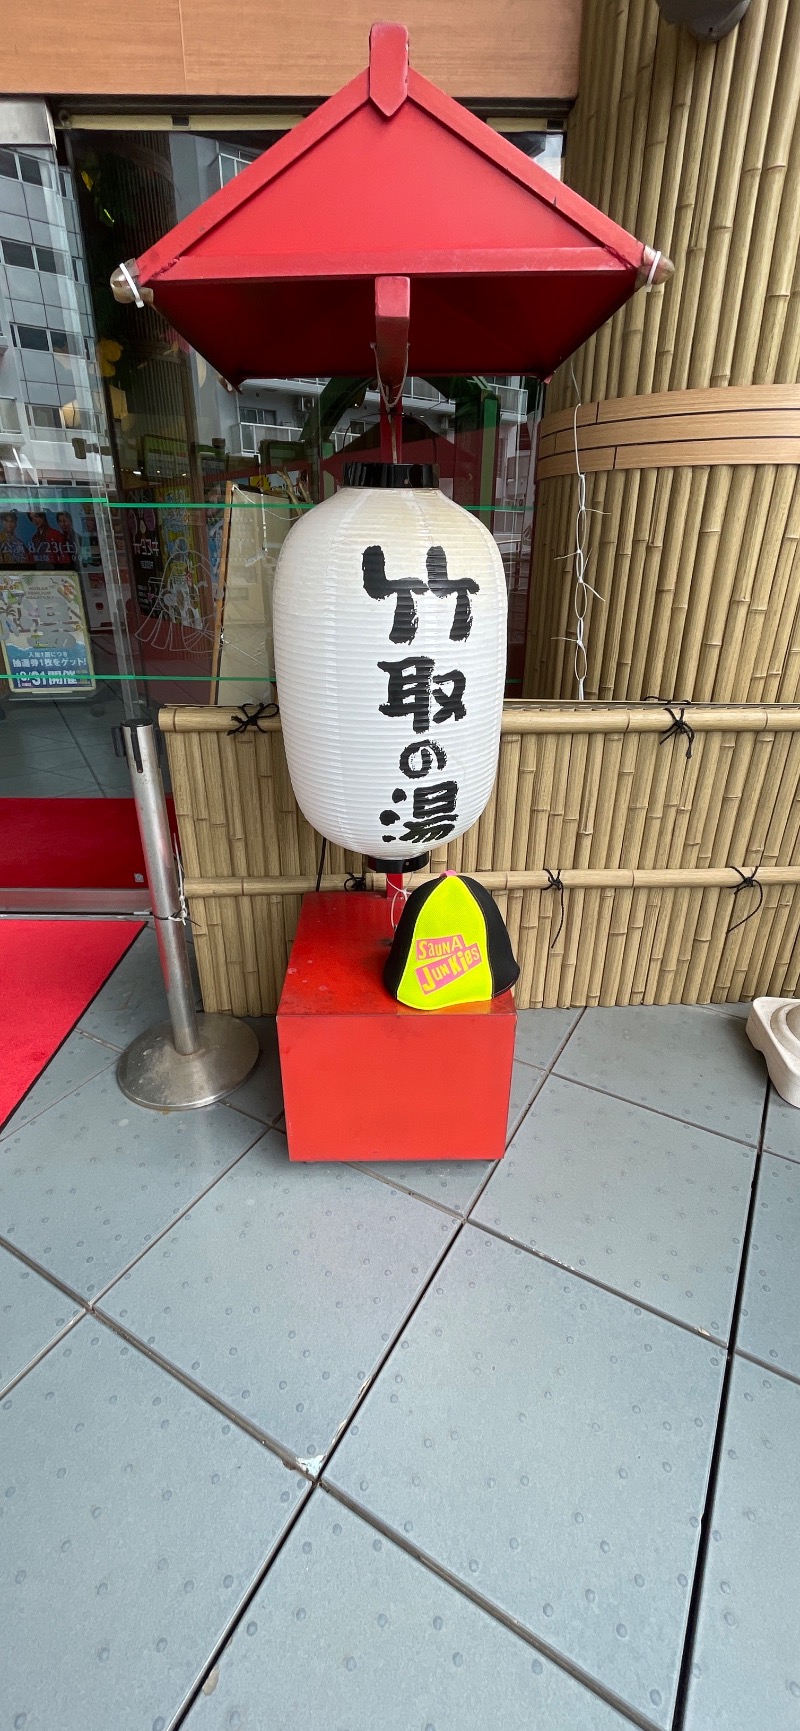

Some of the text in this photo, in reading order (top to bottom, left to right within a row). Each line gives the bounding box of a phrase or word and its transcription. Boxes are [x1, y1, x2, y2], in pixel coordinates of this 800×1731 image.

[28, 541, 77, 555] 8/23(土)
[361, 545, 480, 843] 竹取の湯
